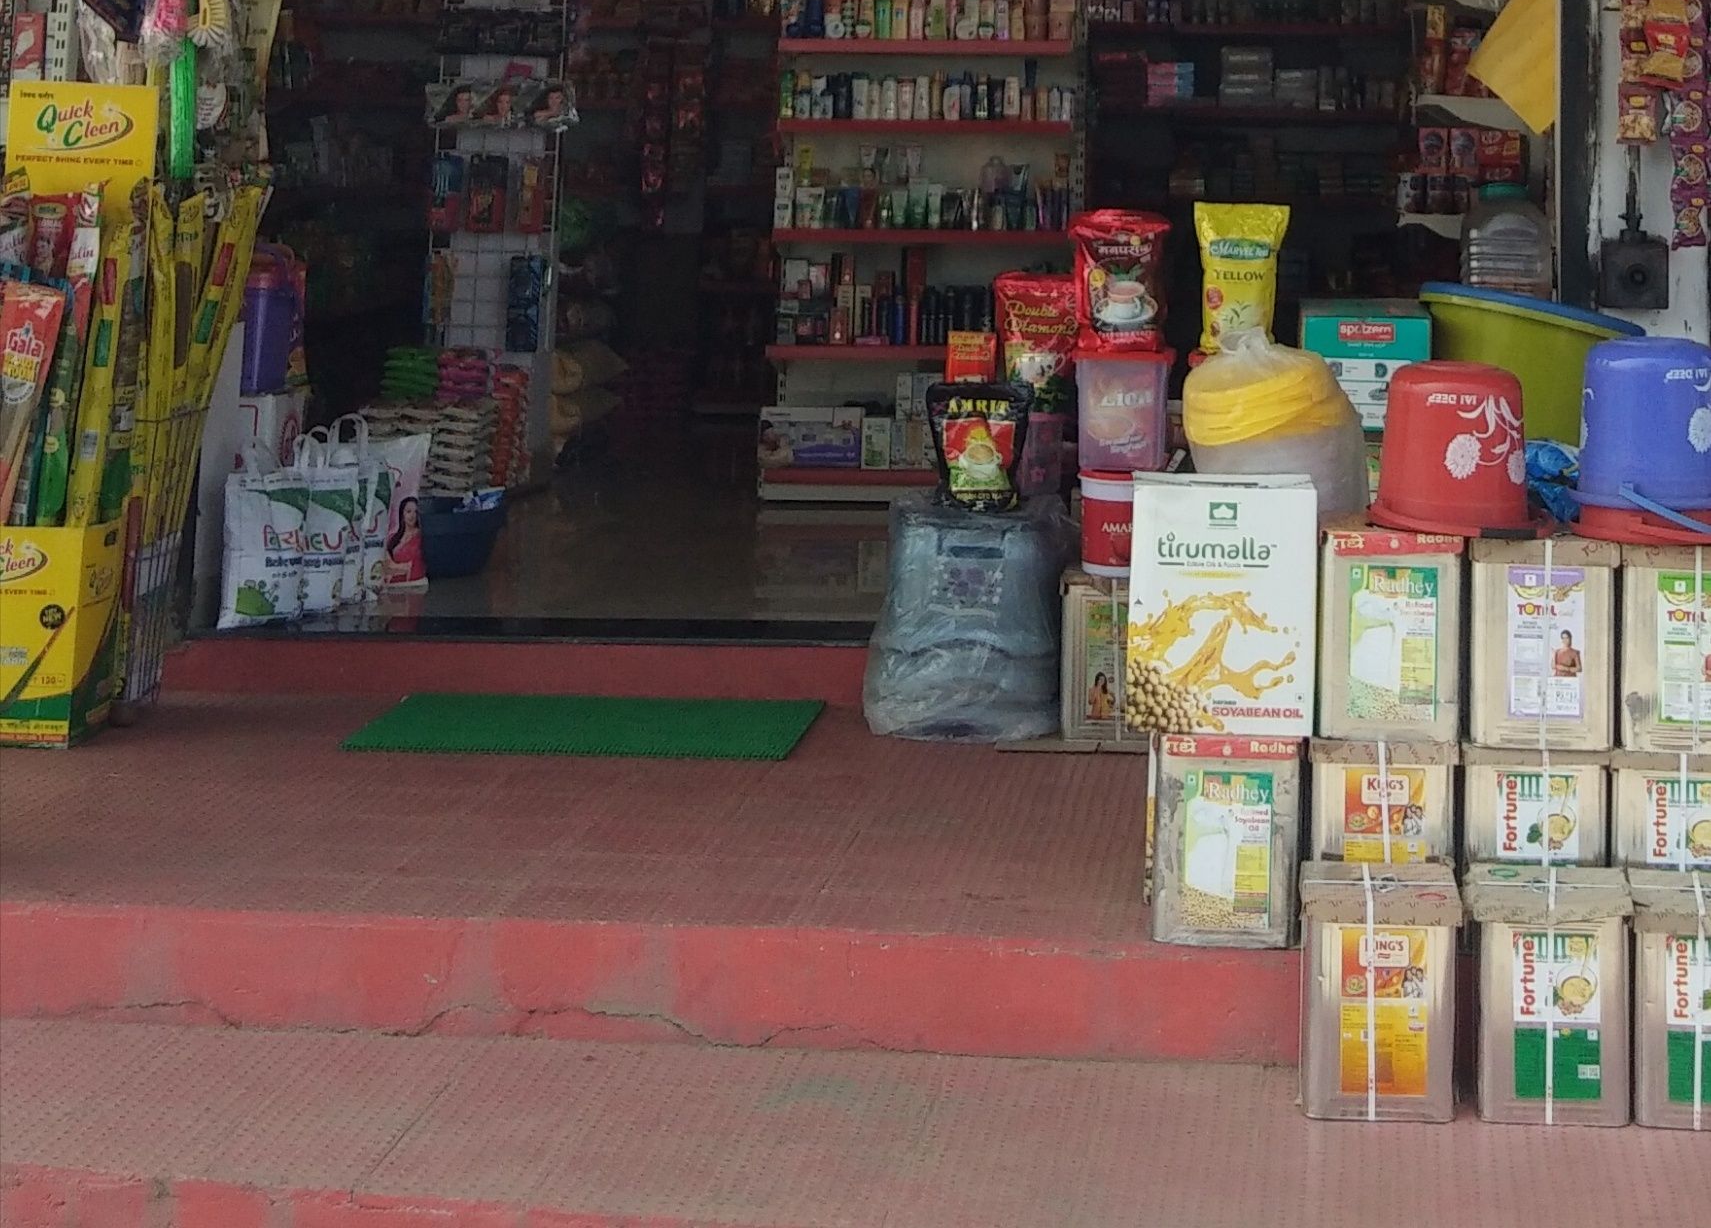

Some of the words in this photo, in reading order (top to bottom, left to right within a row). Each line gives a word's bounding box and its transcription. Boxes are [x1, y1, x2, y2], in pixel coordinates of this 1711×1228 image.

[37, 98, 93, 133] Quick
[63, 120, 119, 147] Cleen
[15, 154, 53, 163] PERFECT
[83, 156, 111, 165] EVERY
[1214, 269, 1265, 282] YELLOW
[1005, 300, 1061, 318] Double
[8, 330, 43, 358] Gala
[1665, 369, 1693, 380] DEEP
[948, 397, 1010, 414] AMRIT
[1428, 393, 1457, 405] DEEP
[1158, 532, 1272, 561] tirumalla
[1373, 574, 1434, 598] Radhey
[1517, 602, 1557, 616] TOTL
[1667, 609, 1707, 623] TOTL
[1212, 706, 1280, 719] SOYABEAN
[1282, 707, 1304, 719] OIL
[1250, 740, 1296, 754] Radhe
[1209, 781, 1270, 804] Radhey
[1503, 779, 1518, 852] Fortune
[1653, 785, 1667, 857] Fortune
[1365, 938, 1405, 952] ING'S
[1520, 939, 1536, 1016] Fortune
[1673, 942, 1689, 1018] Fortune
